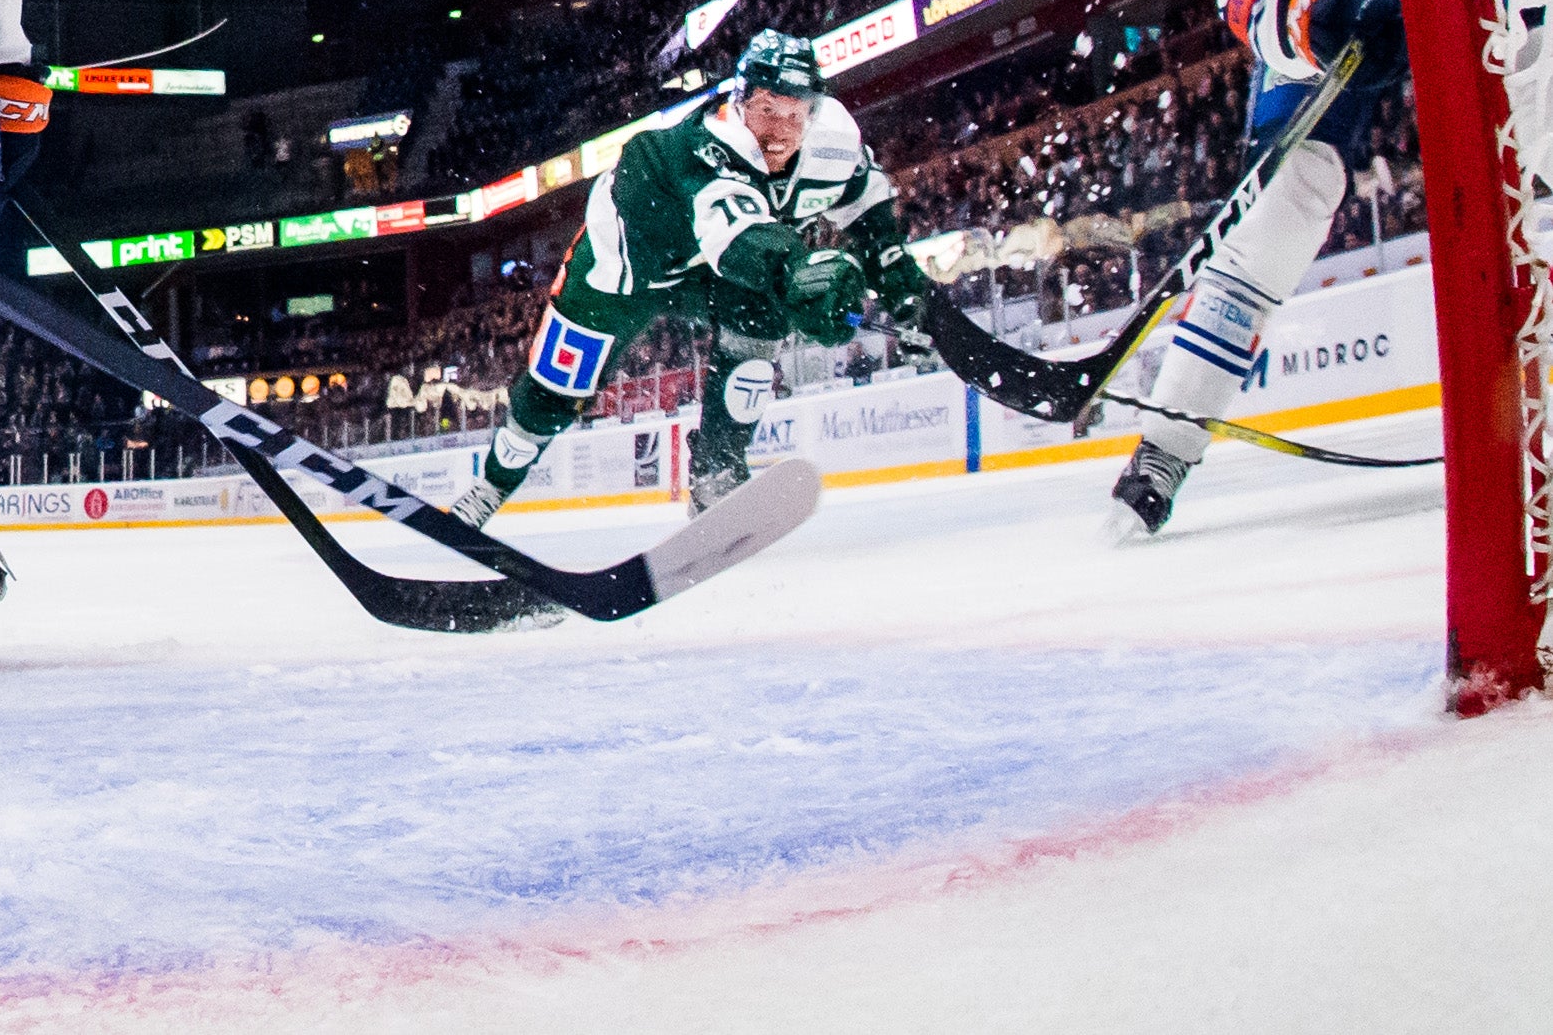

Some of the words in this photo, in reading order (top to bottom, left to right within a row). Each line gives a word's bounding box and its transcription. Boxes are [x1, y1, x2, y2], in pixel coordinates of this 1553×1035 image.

[119, 233, 185, 266] print
[225, 221, 275, 247] PSM
[1282, 333, 1390, 376] MIDROC
